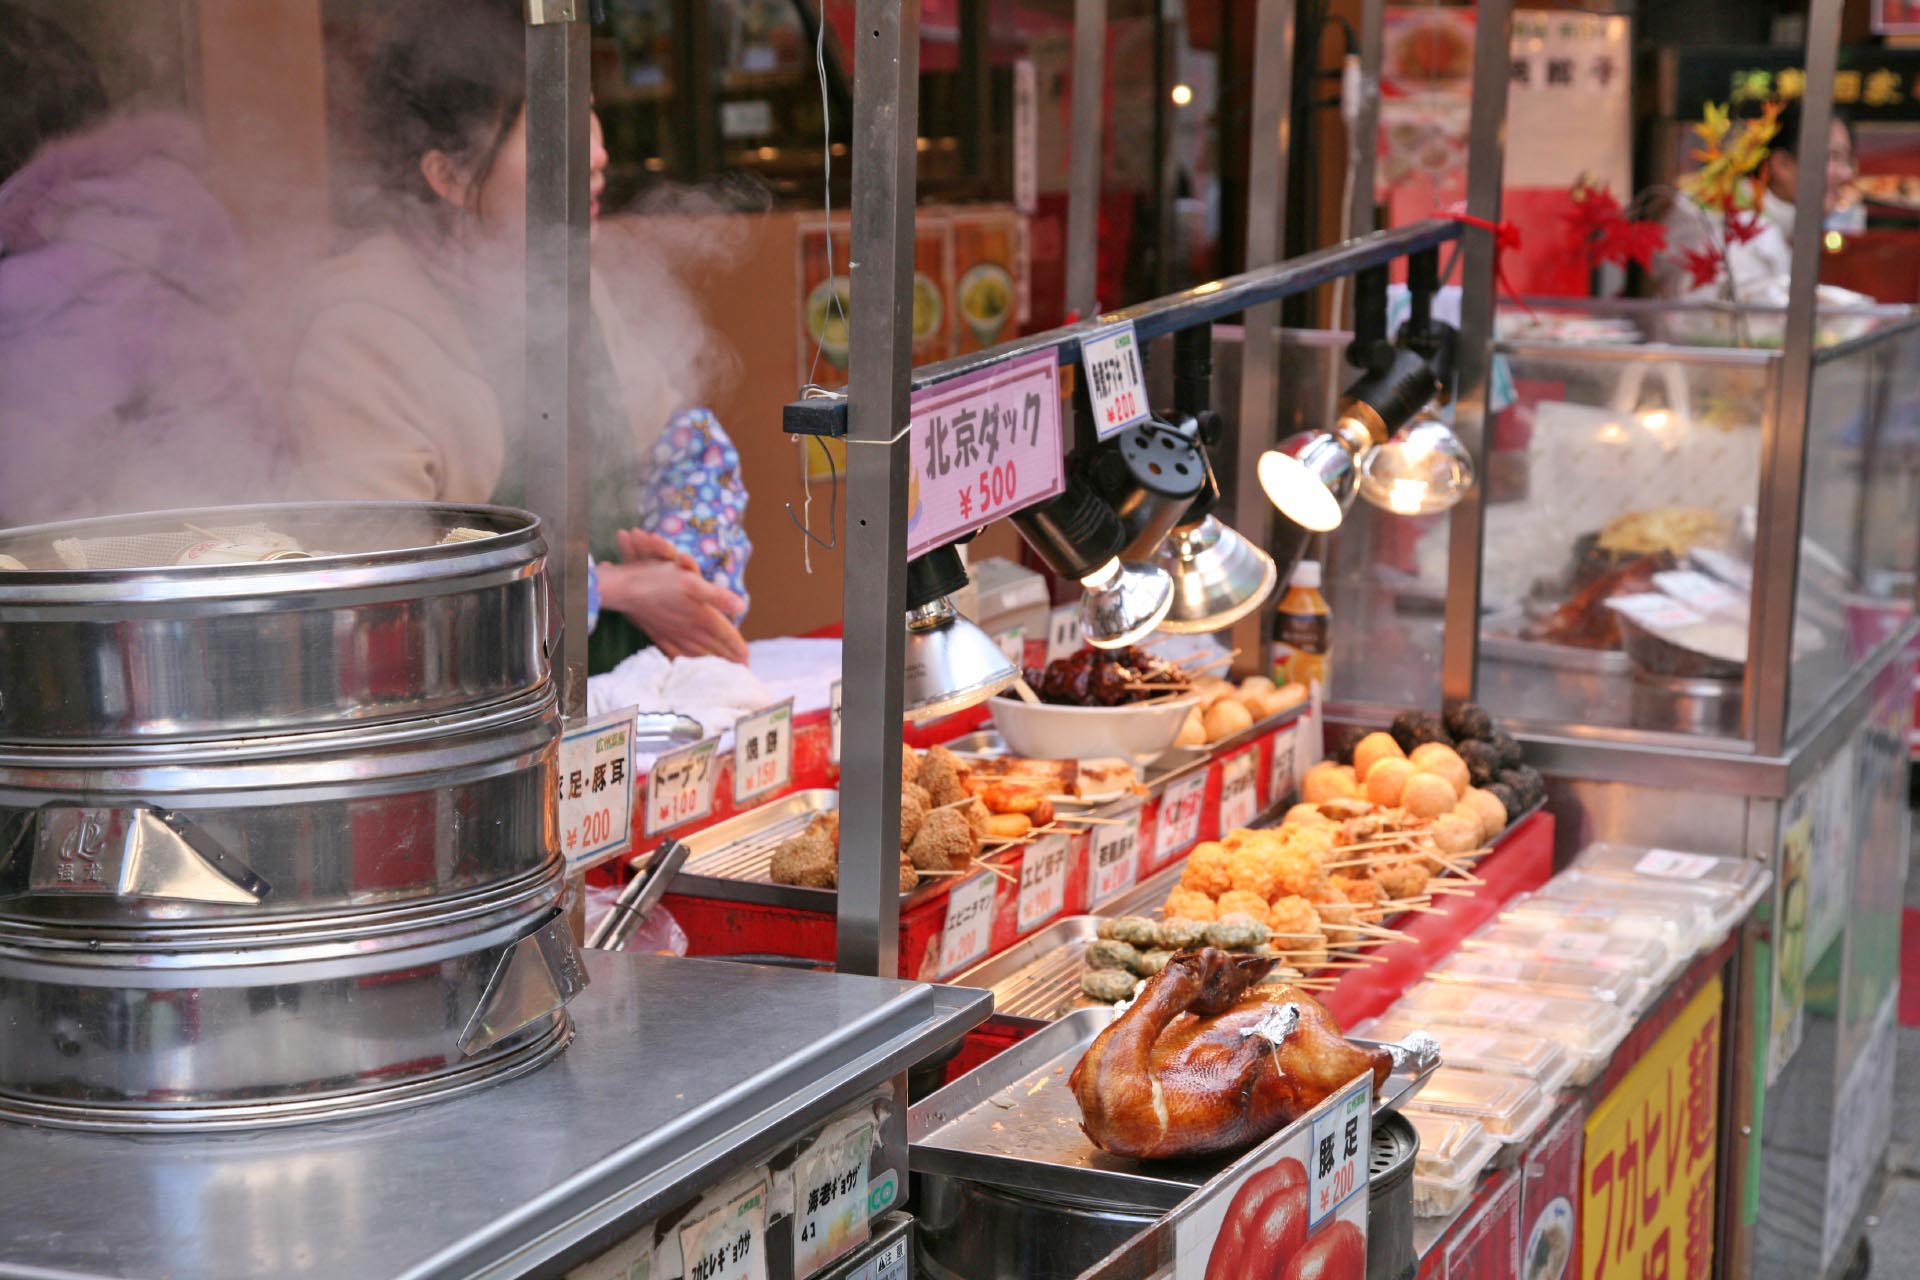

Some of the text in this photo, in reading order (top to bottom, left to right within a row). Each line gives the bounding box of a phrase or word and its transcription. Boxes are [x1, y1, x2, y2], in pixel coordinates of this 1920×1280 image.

[925, 392, 1041, 481] 北京ダック
[1318, 1115, 1359, 1180] 豚足
[806, 1161, 862, 1216] 海老ギョウザ
